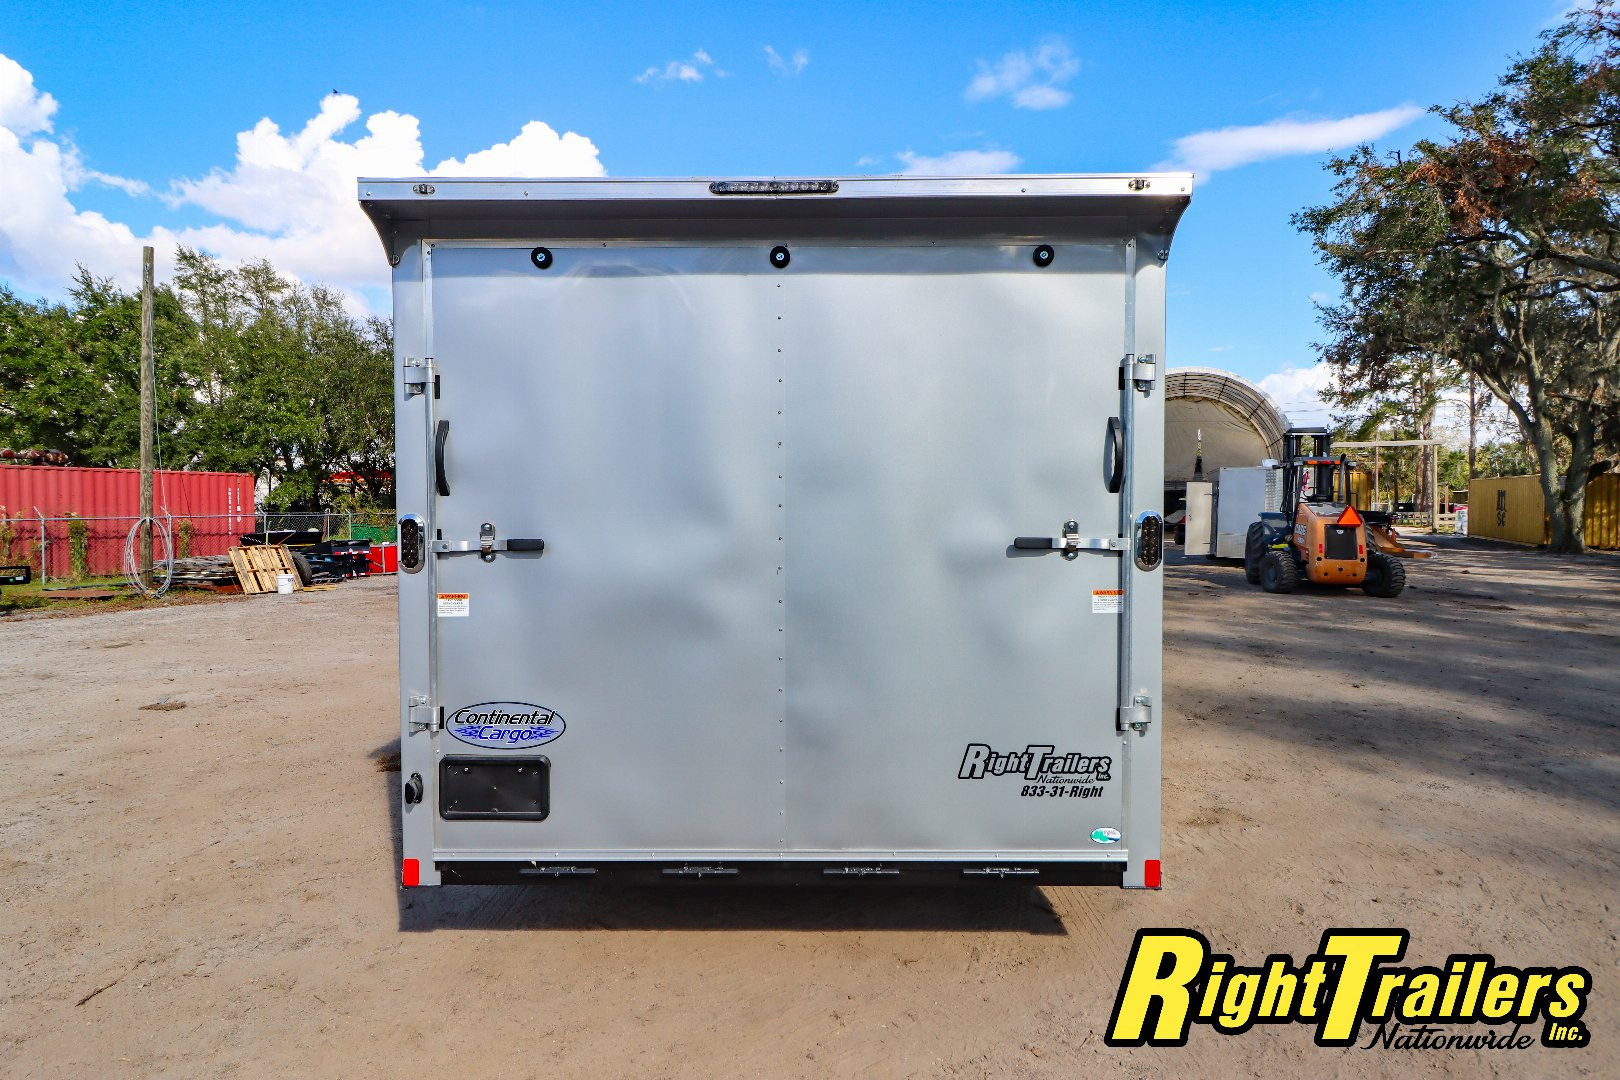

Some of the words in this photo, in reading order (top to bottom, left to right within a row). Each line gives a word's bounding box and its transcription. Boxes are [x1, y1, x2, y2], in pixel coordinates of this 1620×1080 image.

[454, 709, 556, 725] Continental
[478, 725, 533, 744] Cargo
[1036, 774, 1095, 784] Nationwide
[1021, 785, 1104, 798] 833-31-Right
